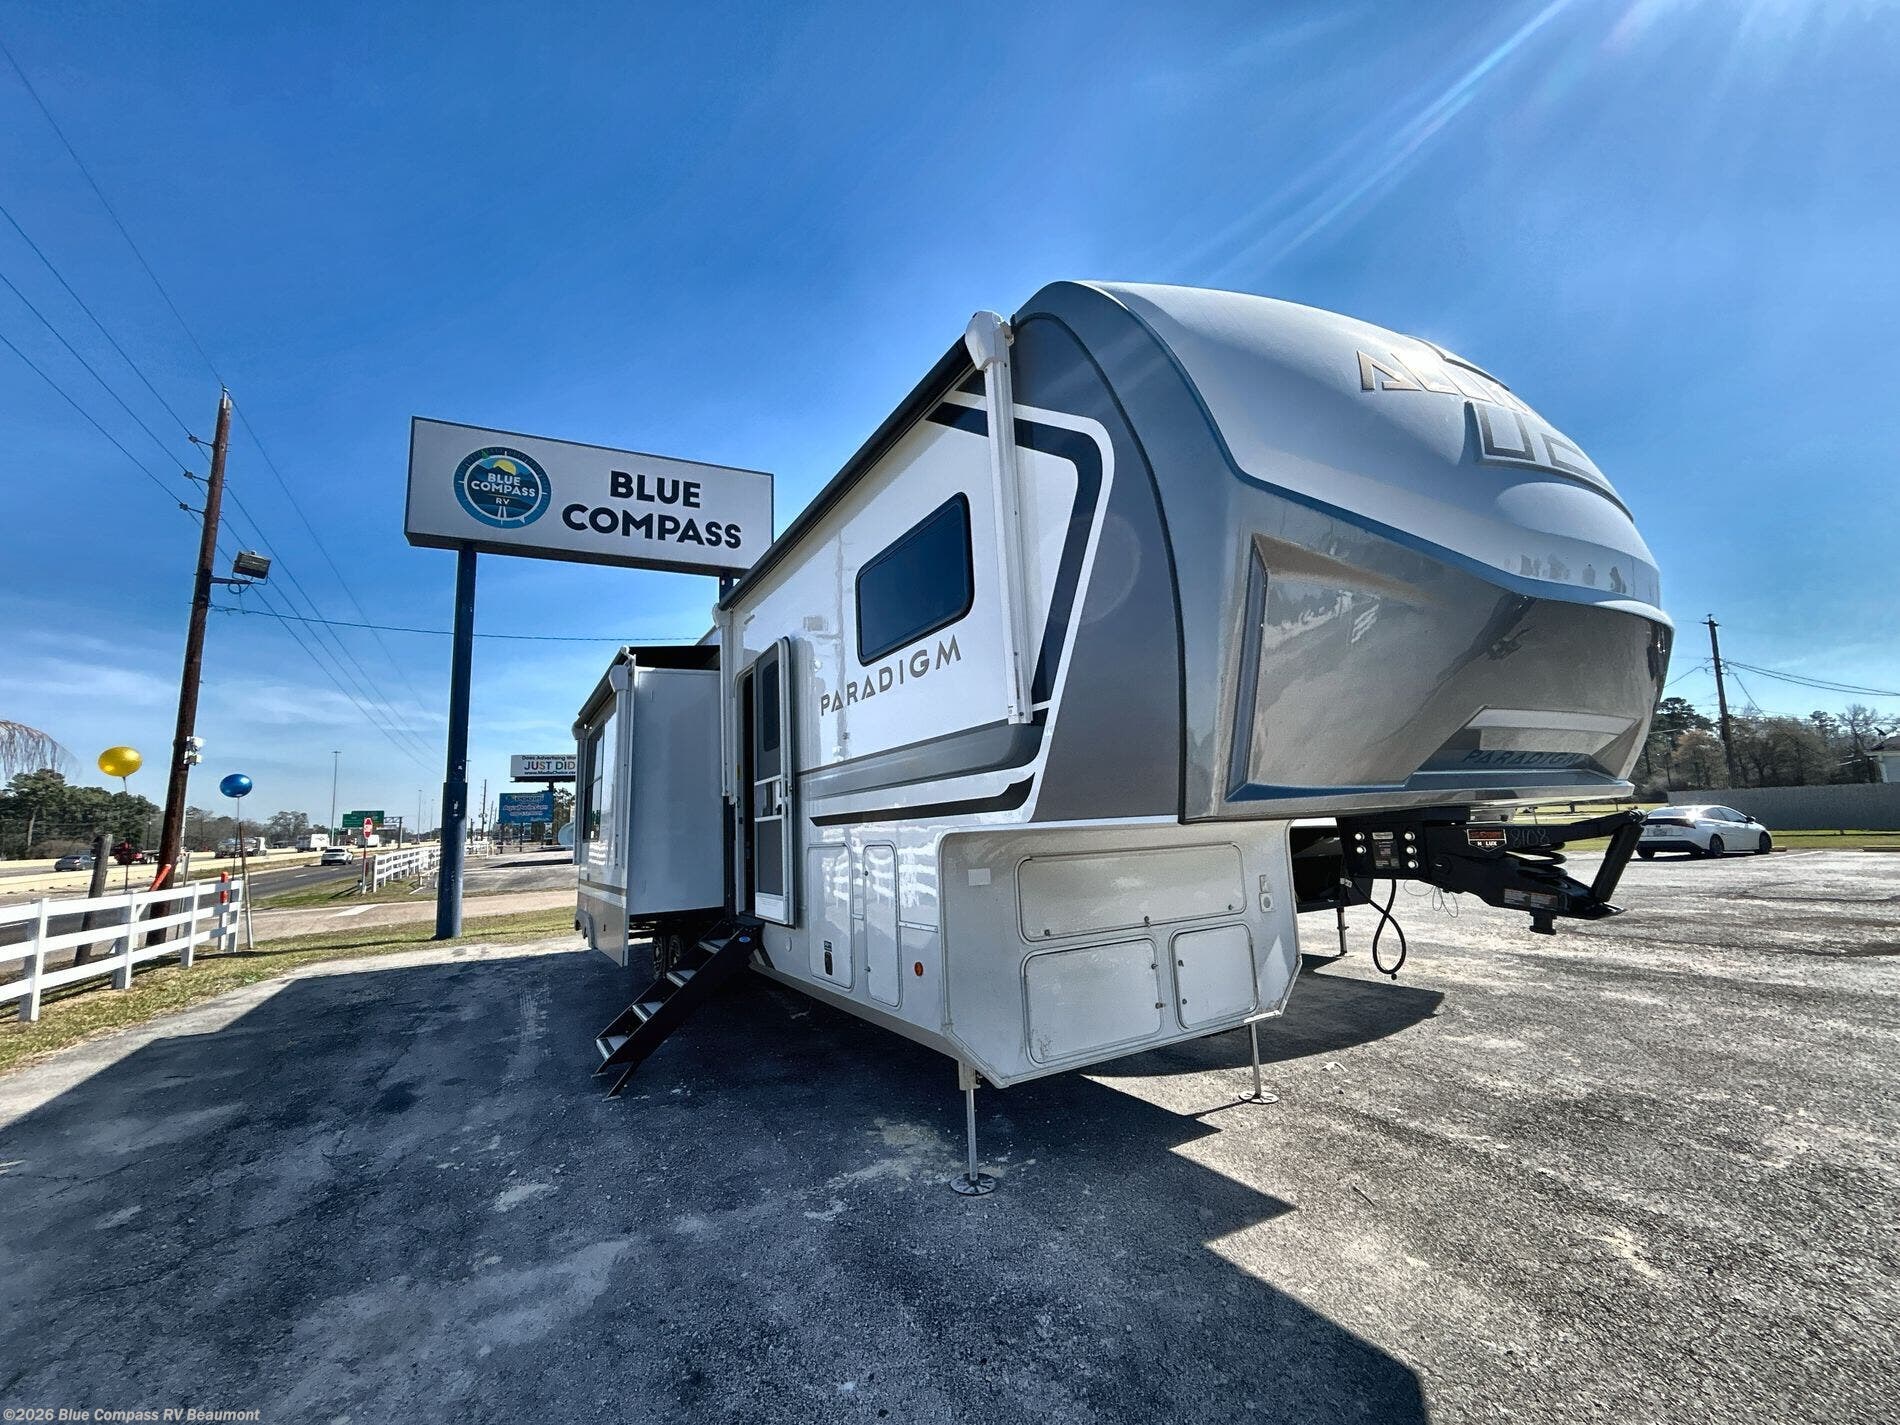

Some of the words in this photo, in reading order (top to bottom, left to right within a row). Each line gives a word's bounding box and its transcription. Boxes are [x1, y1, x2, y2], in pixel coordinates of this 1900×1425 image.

[487, 472, 521, 486] BLUE
[471, 480, 536, 498] COMPASS
[610, 470, 701, 509] BLUE
[495, 497, 510, 505] RV
[562, 503, 742, 549] COMPASS
[820, 634, 962, 717] PARADIGM
[524, 761, 552, 770] JUST
[555, 761, 576, 770] DID
